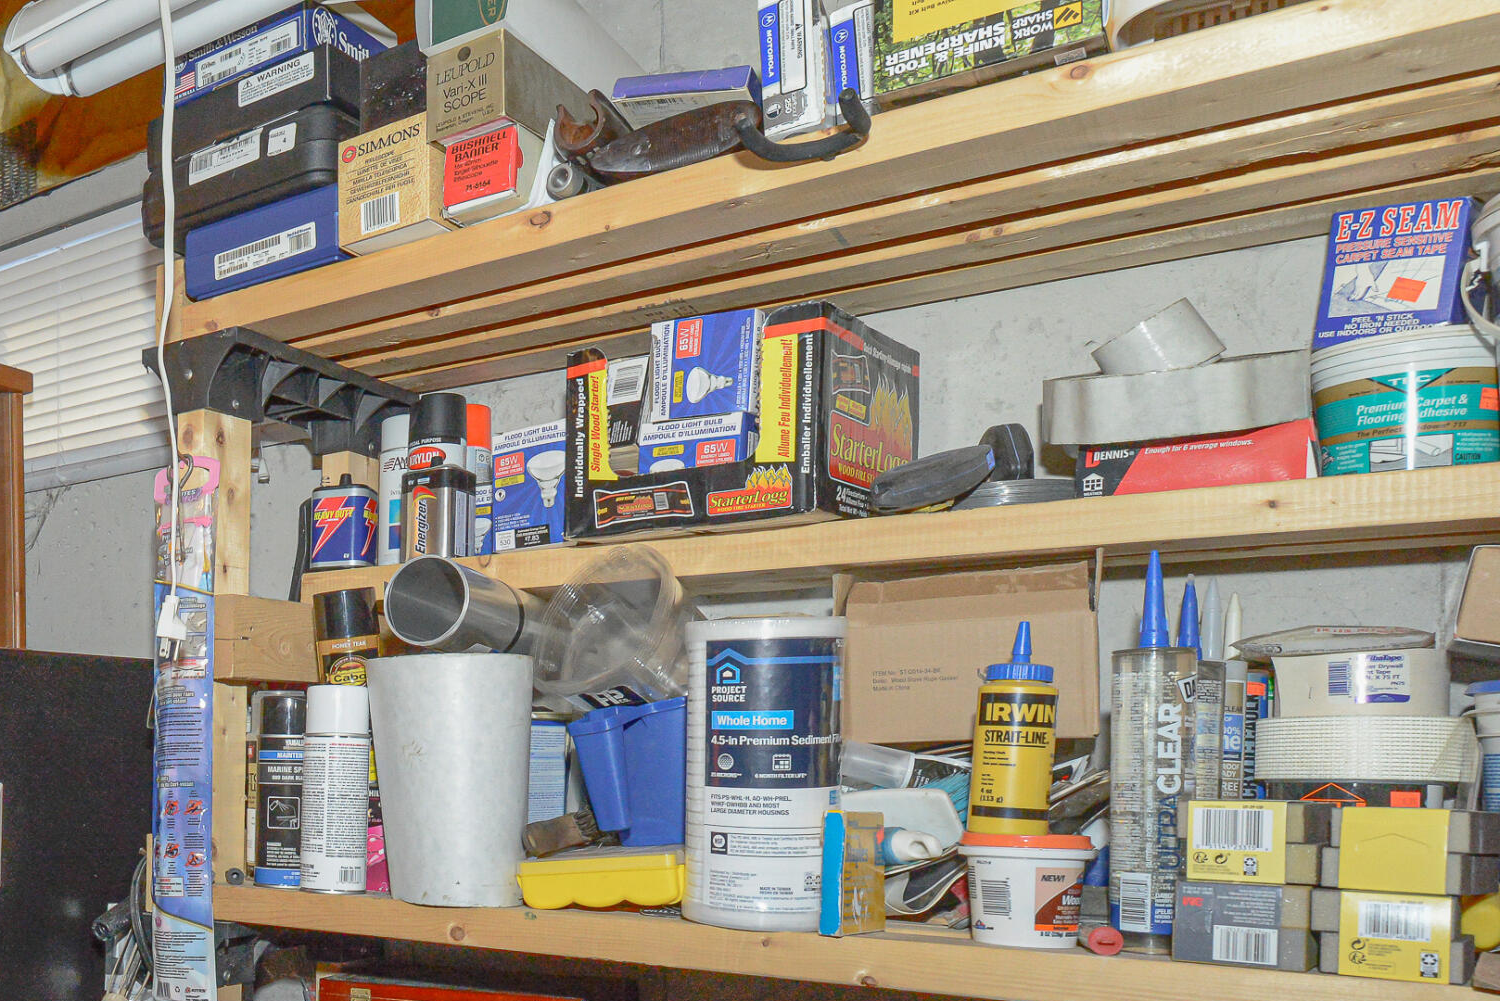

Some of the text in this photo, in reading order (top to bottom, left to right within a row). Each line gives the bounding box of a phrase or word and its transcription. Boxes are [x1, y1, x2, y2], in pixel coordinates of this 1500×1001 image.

[1013, 9, 1053, 29] SHARP
[1013, 21, 1053, 40] WORK
[188, 39, 216, 62] Smith
[222, 25, 258, 47] Wesson
[885, 21, 1005, 66] SHARPENER
[766, 29, 775, 78] MOTOROLA
[885, 33, 1005, 77] KNIFE & TOOL
[257, 58, 301, 82] WARNING
[436, 52, 496, 86] LEUPOLD
[838, 45, 849, 89] MOTOROL
[443, 73, 488, 99] Vari-X III
[443, 87, 487, 113] SCOPE
[784, 98, 792, 114] 250
[358, 122, 421, 157] SIMMONS
[451, 131, 508, 155] BUSHNELL
[454, 142, 501, 163] BANNER
[1335, 200, 1463, 243] E-Z SEAM
[1335, 231, 1454, 255] PRESSURE SENSITIVE
[1335, 243, 1448, 265] CARPET SEAM TAPE
[1344, 318, 1420, 331] NO IRON NEEDED
[1351, 315, 1374, 324] PEEL
[1386, 312, 1414, 321] STICK
[1318, 325, 1393, 339] USE INDOORS OR
[1387, 373, 1431, 388] TC
[776, 338, 793, 459] Individuellement! Feu Allume
[800, 333, 815, 475] Individuellement Emballer
[1458, 394, 1468, 405] &
[1416, 405, 1469, 420] dhesive
[504, 424, 559, 441] FLOOD LIGHT BULB
[590, 375, 602, 473] Starter! Wood Single
[642, 424, 737, 442] AMPOULE D'ILLUMINATION
[657, 417, 723, 432] FLOOD LIGHT BULB
[421, 437, 442, 445] PURPOSE
[494, 441, 521, 452] AMPOULE
[574, 377, 586, 498] Wrapped Individually
[1093, 449, 1130, 462] DENNIS
[1145, 446, 1171, 456] Enough
[1172, 445, 1182, 453] for
[1189, 441, 1218, 453] average
[1219, 438, 1254, 449] windows.
[709, 488, 788, 509] StarterLogg
[837, 486, 847, 502] 24
[415, 500, 428, 554] Energizer
[332, 639, 367, 649] HONEY TEAK
[333, 672, 368, 684] Cabo
[711, 685, 747, 694] PROJECT
[711, 694, 746, 702] SOURCE
[716, 715, 787, 726] Whole Home
[985, 701, 1056, 724] IRWIN
[711, 734, 833, 746] 4.5-in Premium Sediment
[1157, 702, 1182, 795] CLEAR
[267, 765, 293, 774] MARINE
[710, 807, 727, 815] LARGE
[727, 808, 757, 816] DIAMETER
[1041, 874, 1066, 883] NEW!
[1182, 896, 1203, 907] 3M
